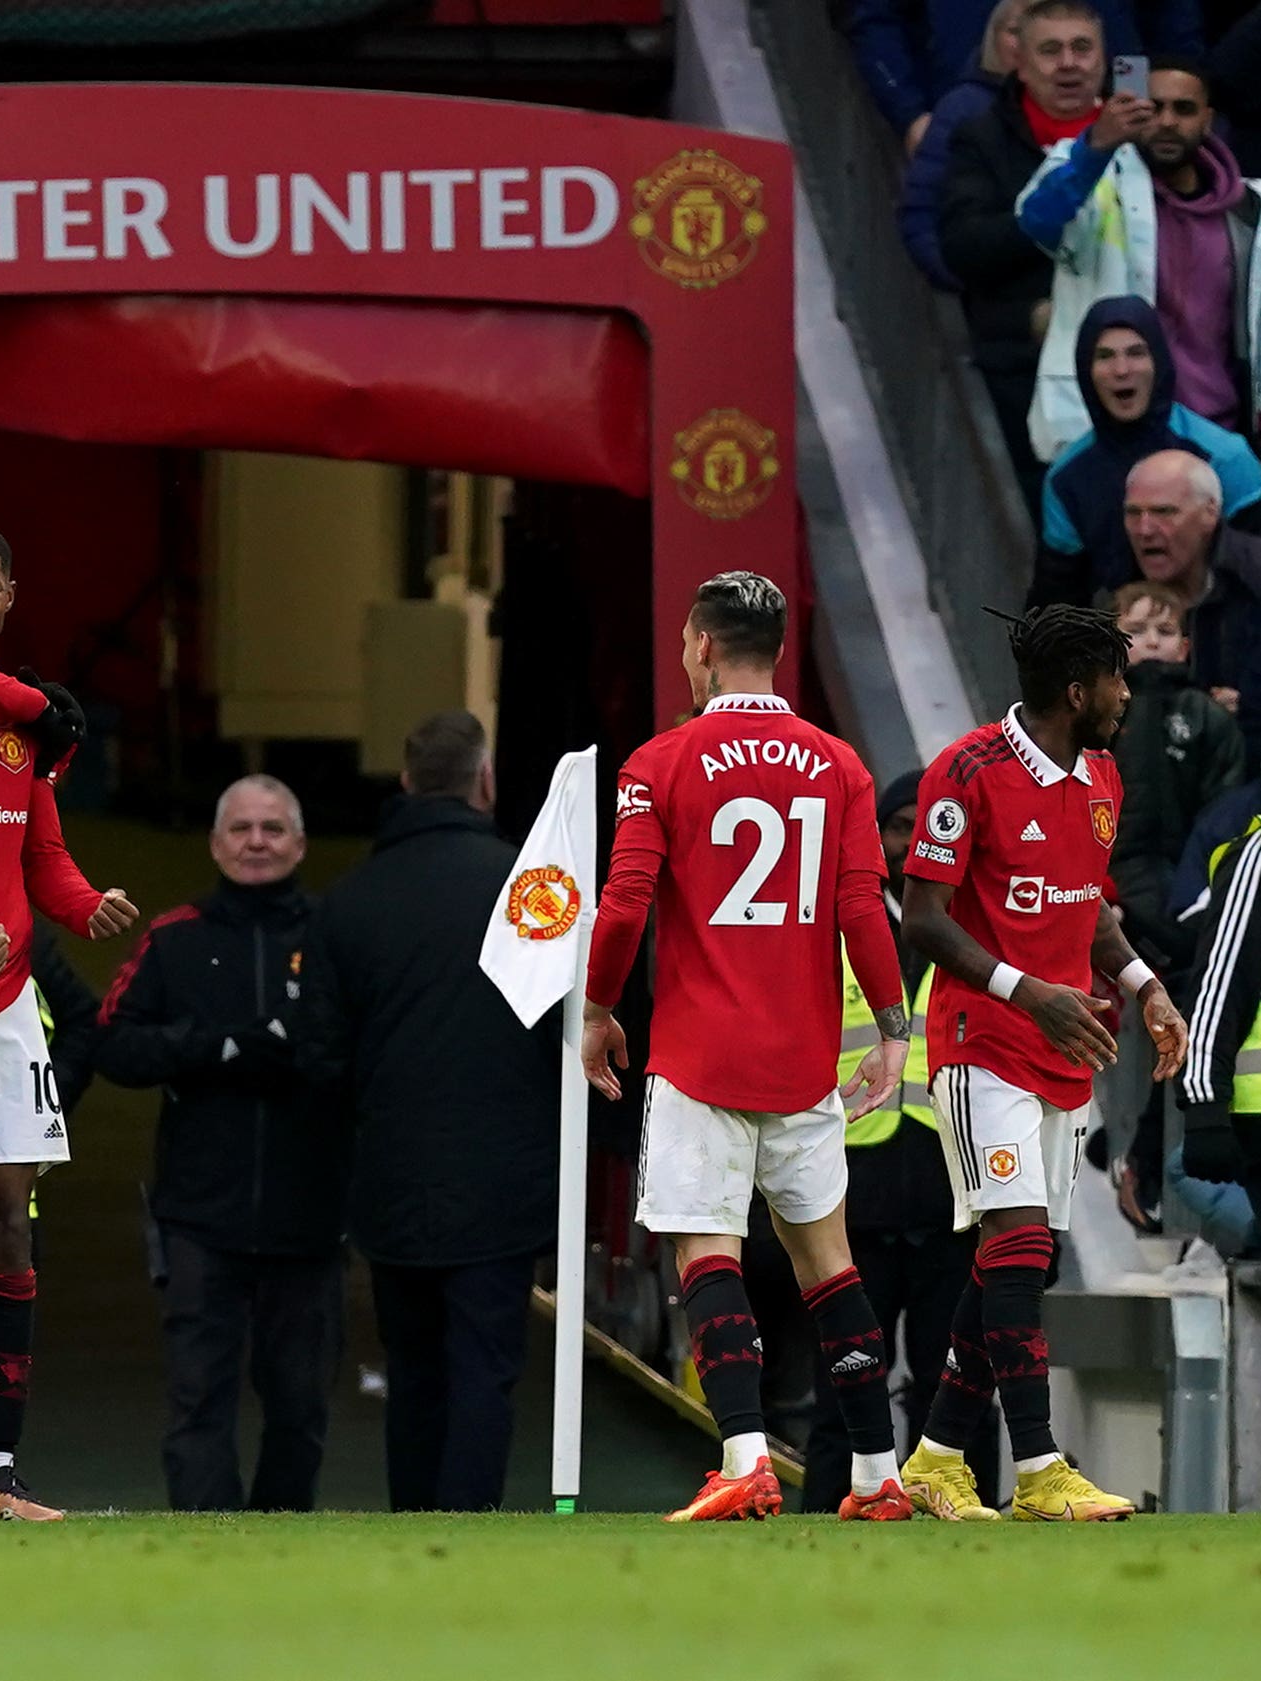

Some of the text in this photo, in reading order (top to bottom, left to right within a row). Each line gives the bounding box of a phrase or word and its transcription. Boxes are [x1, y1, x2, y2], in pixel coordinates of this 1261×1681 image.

[204, 166, 619, 258] UNITED
[700, 739, 832, 782] ANTONY
[708, 796, 826, 926] 21
[510, 868, 560, 920] MANCHESTER
[542, 902, 579, 939] UNITED
[30, 1061, 61, 1115] 10
